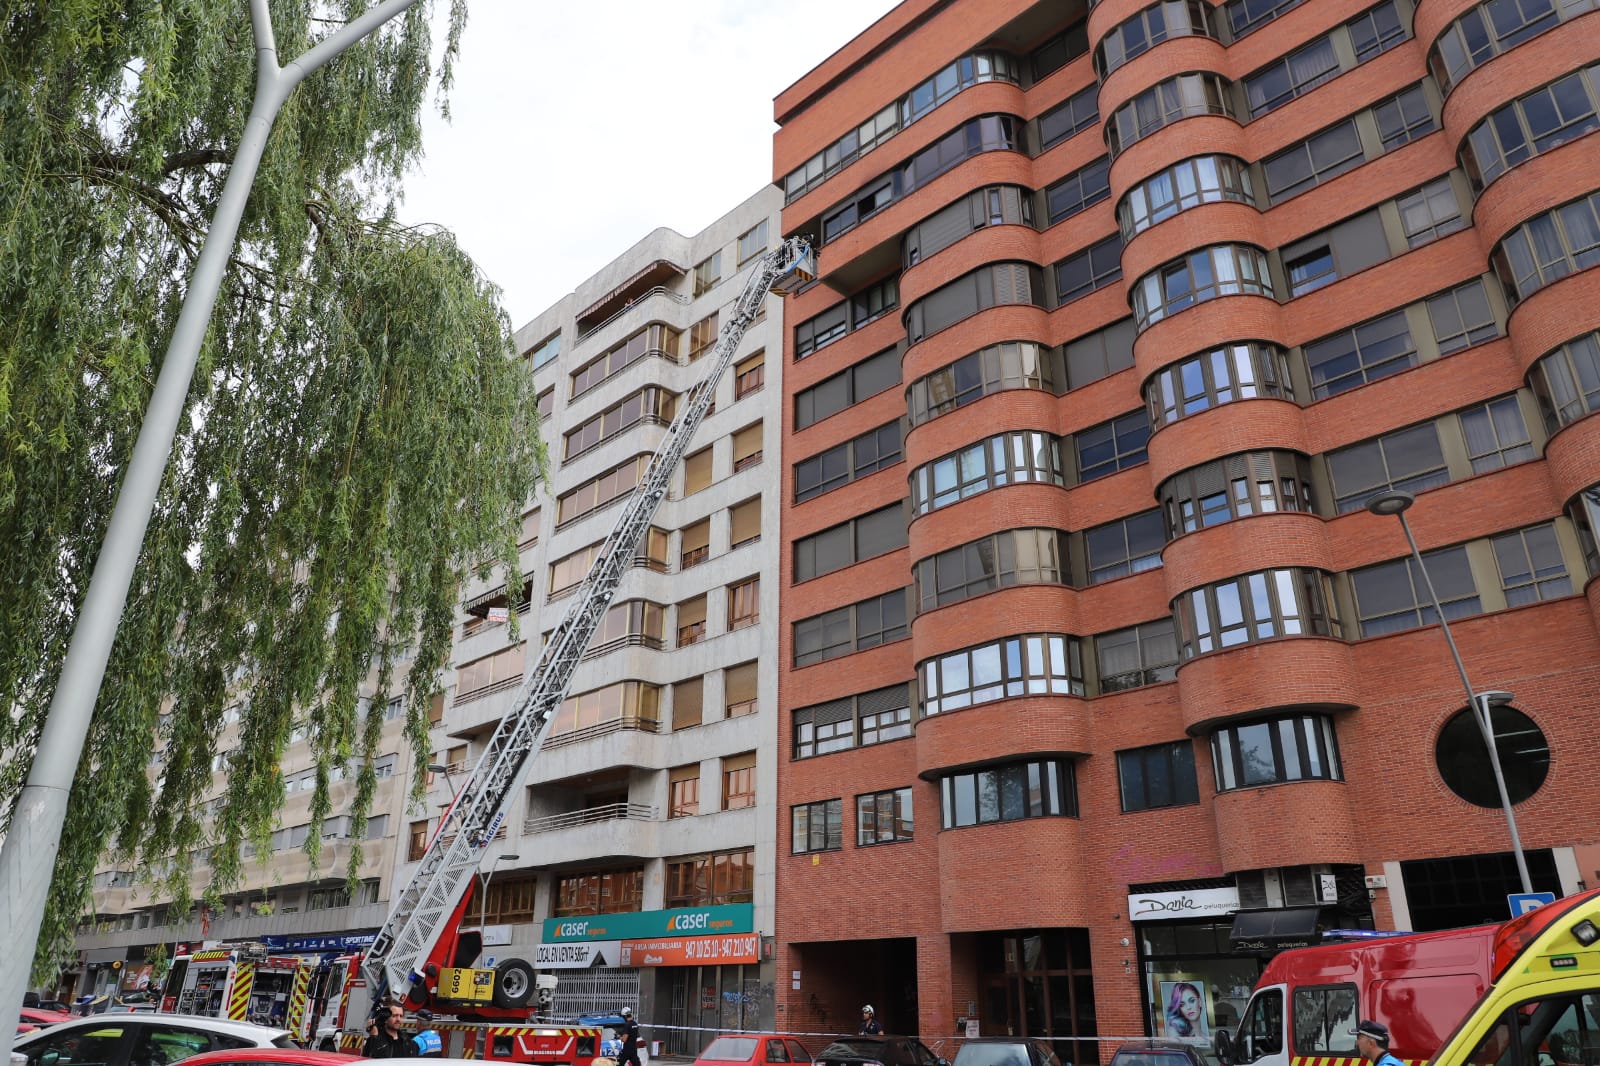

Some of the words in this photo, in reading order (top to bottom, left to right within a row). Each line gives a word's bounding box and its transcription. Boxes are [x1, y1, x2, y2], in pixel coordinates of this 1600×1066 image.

[1135, 896, 1202, 916] Dania
[561, 921, 589, 936] caser
[675, 912, 710, 930] caser
[685, 940, 696, 959] 947
[711, 938, 719, 958] 10
[722, 939, 733, 957] 947
[745, 937, 756, 956] 947
[451, 968, 461, 993] 6602
